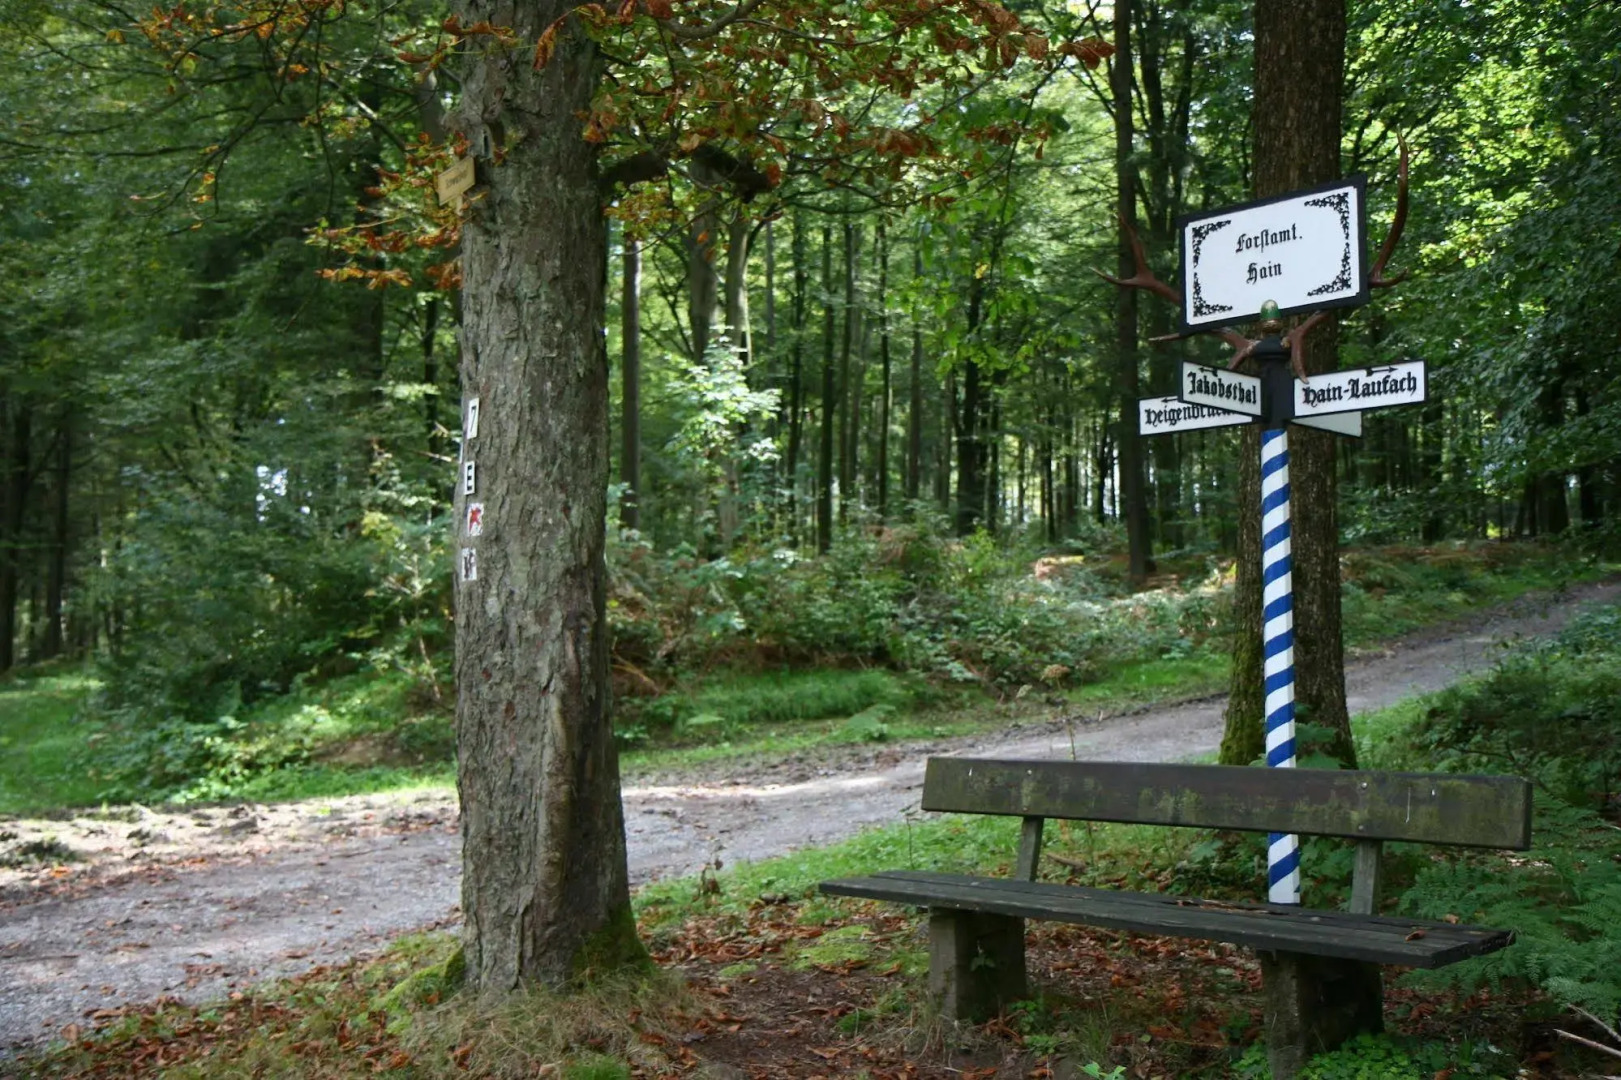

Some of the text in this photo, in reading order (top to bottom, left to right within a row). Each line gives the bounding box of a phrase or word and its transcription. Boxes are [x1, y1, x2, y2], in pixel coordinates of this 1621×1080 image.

[1246, 260, 1282, 285] Hain
[1187, 371, 1257, 405] Jakobsthal
[1302, 371, 1417, 407] Hain-Laufach
